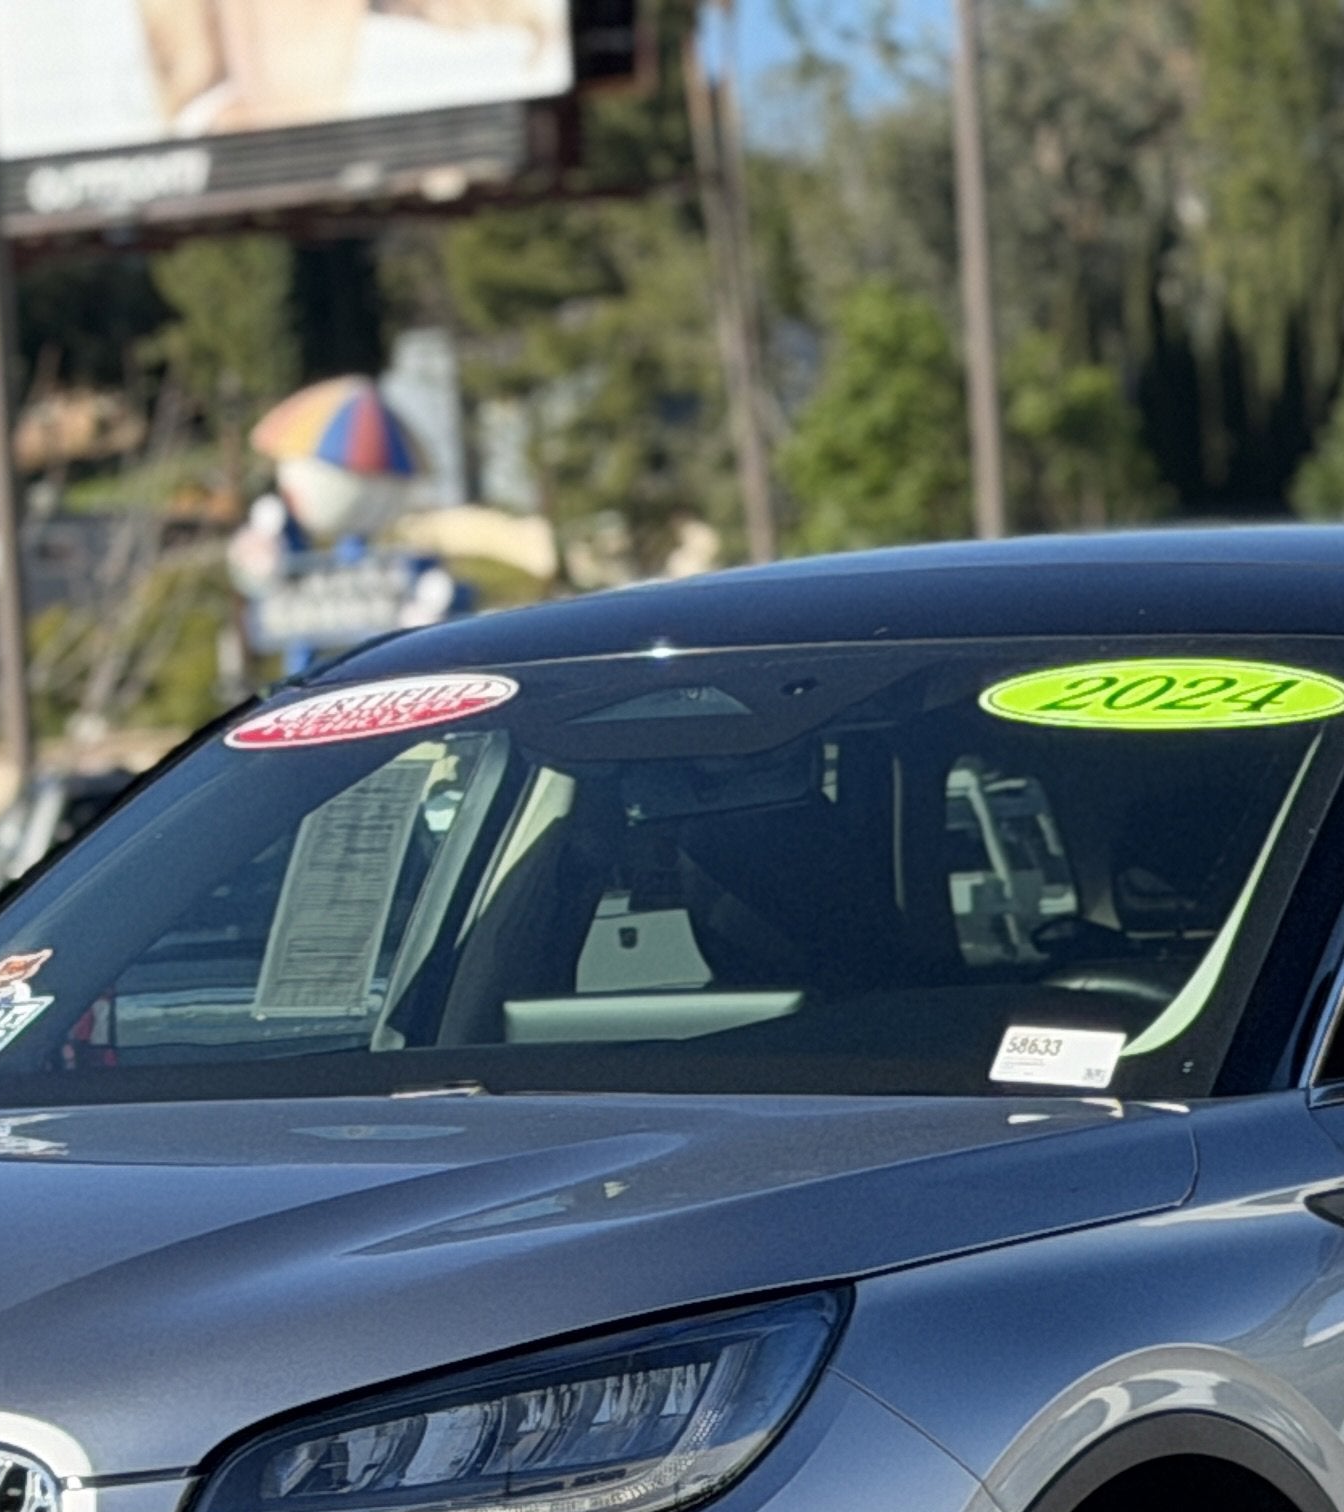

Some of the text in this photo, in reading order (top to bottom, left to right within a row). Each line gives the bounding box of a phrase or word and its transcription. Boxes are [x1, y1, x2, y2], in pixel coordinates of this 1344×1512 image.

[273, 681, 493, 725] CERTIFIED
[1035, 674, 1302, 714] 2024
[1005, 1036, 1064, 1057] 58633
